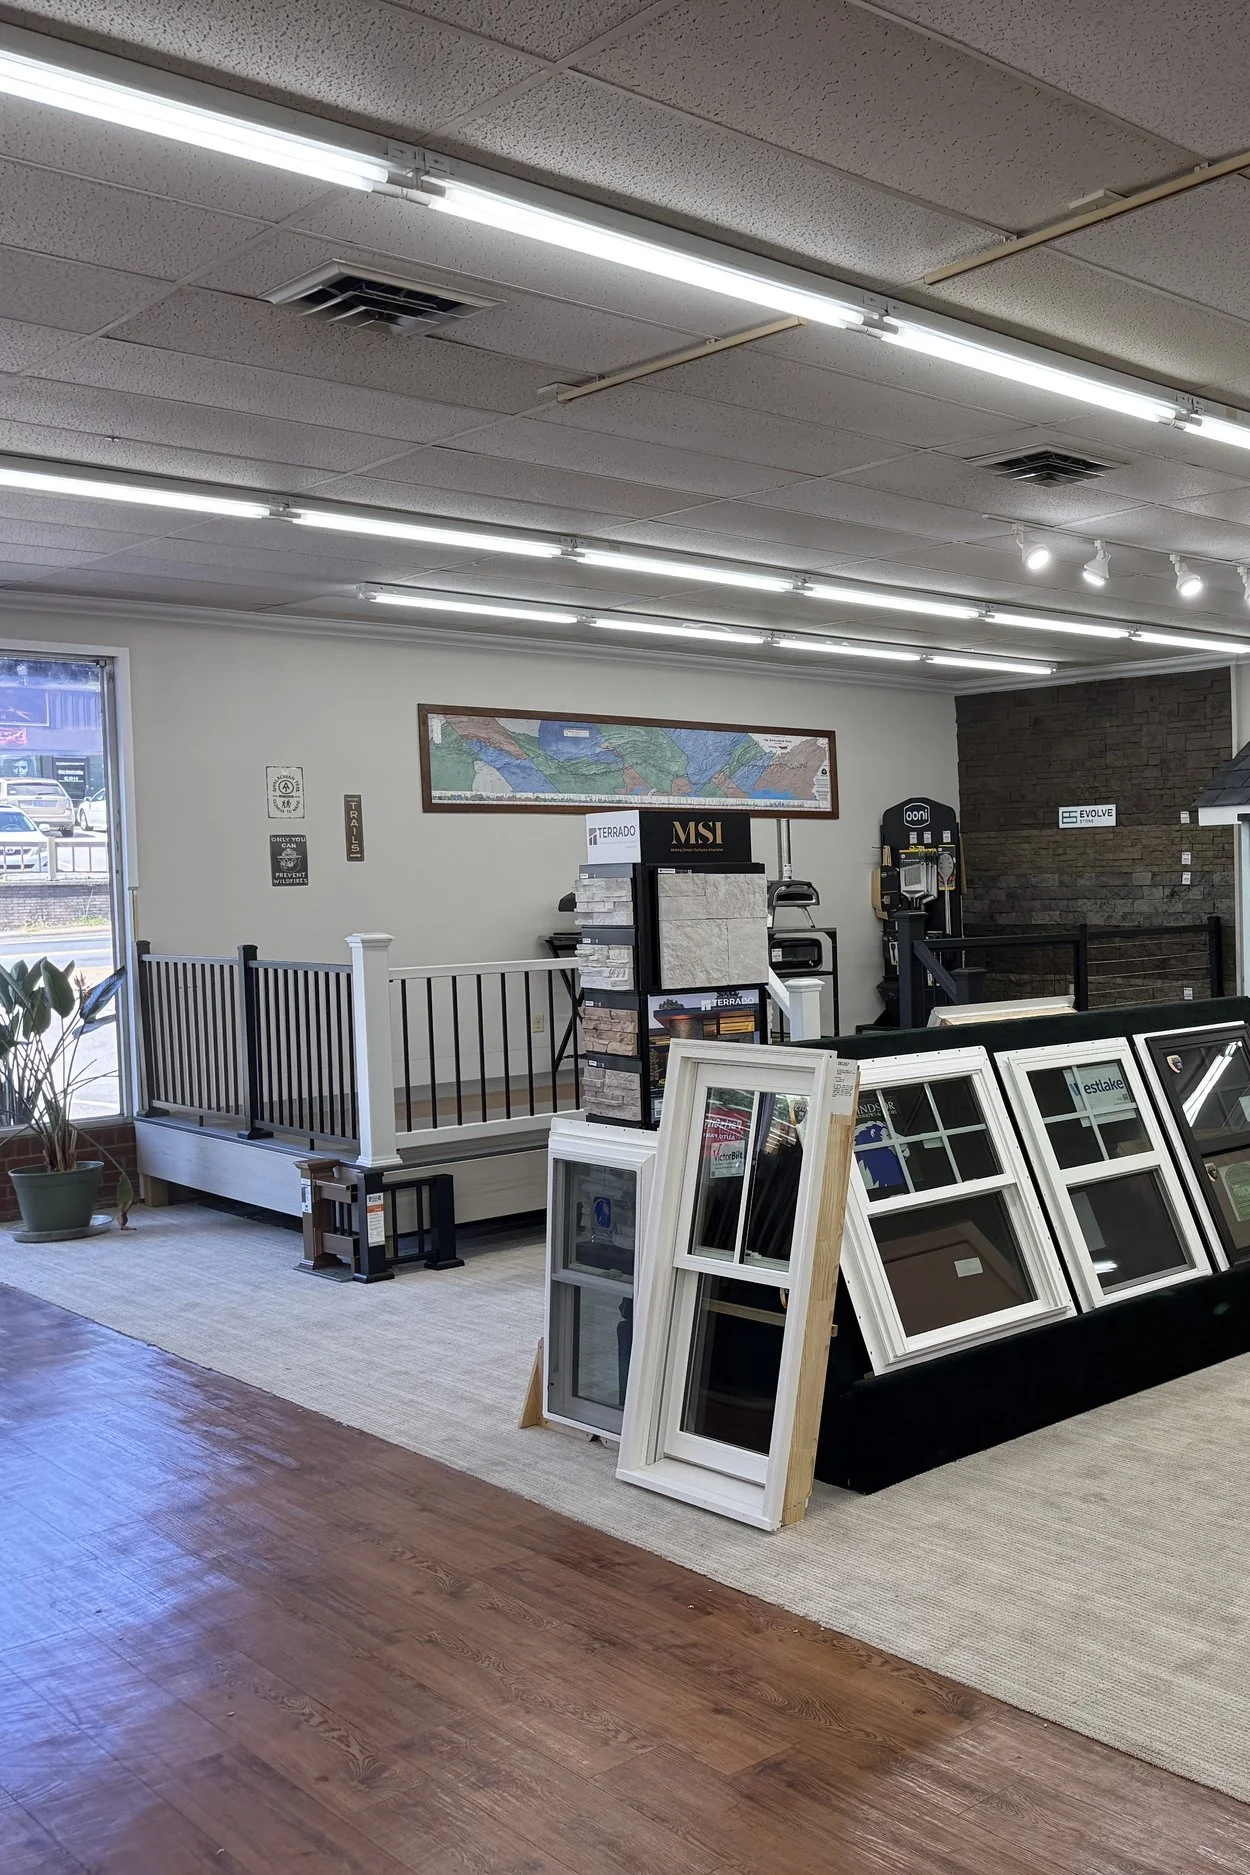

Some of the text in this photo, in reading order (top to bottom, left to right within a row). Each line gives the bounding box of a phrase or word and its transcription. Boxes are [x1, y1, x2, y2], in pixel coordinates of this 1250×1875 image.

[906, 809, 928, 820] ooni
[1080, 809, 1113, 818] EVOLVE
[350, 802, 360, 852] TRAILS
[598, 825, 636, 838] TERRADO
[672, 821, 723, 844] MSI
[712, 997, 755, 1007] TERRADO
[713, 1147, 743, 1162] VictorBilt
